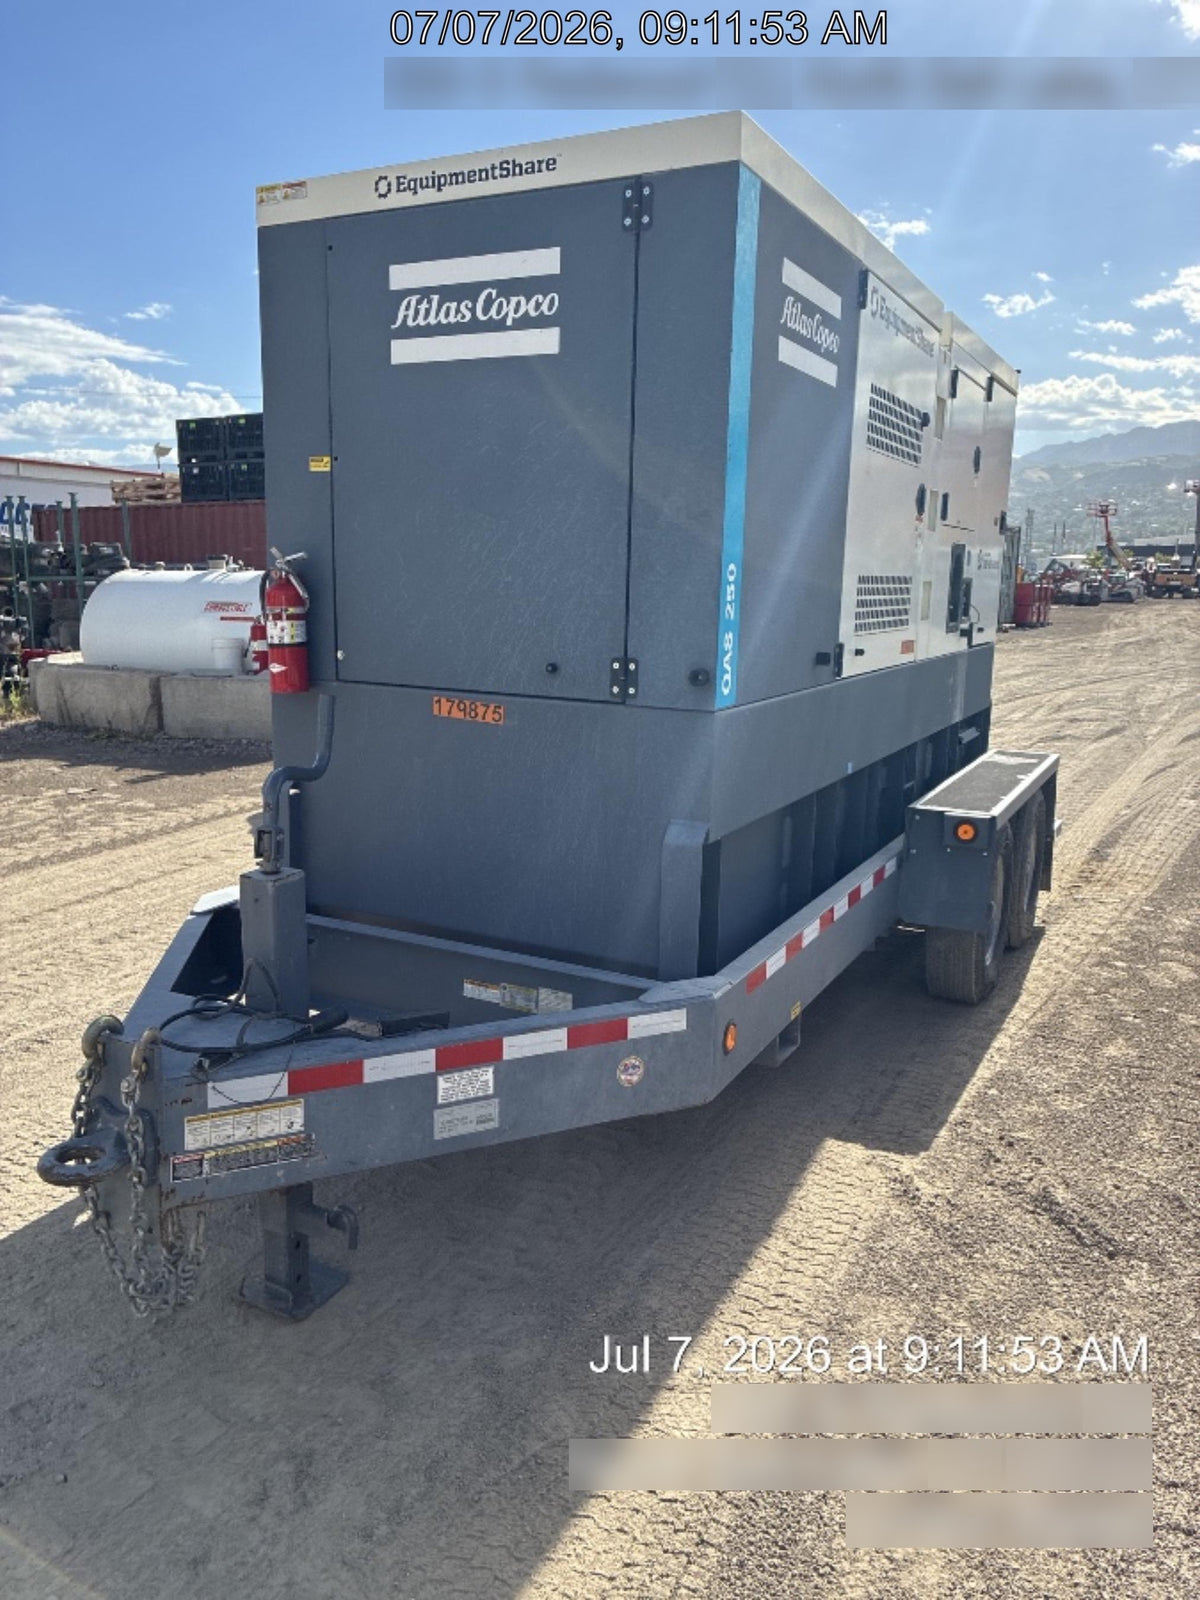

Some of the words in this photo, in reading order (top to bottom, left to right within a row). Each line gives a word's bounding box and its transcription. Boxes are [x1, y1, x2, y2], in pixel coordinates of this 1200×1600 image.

[396, 157, 557, 196] EquipmentShare
[390, 294, 472, 329] Atlas
[476, 288, 559, 326] Copco
[780, 296, 812, 339] Atlas
[812, 313, 840, 354] Copco
[725, 562, 737, 621] 250
[721, 631, 734, 696] QAS
[434, 697, 503, 723] 179875
